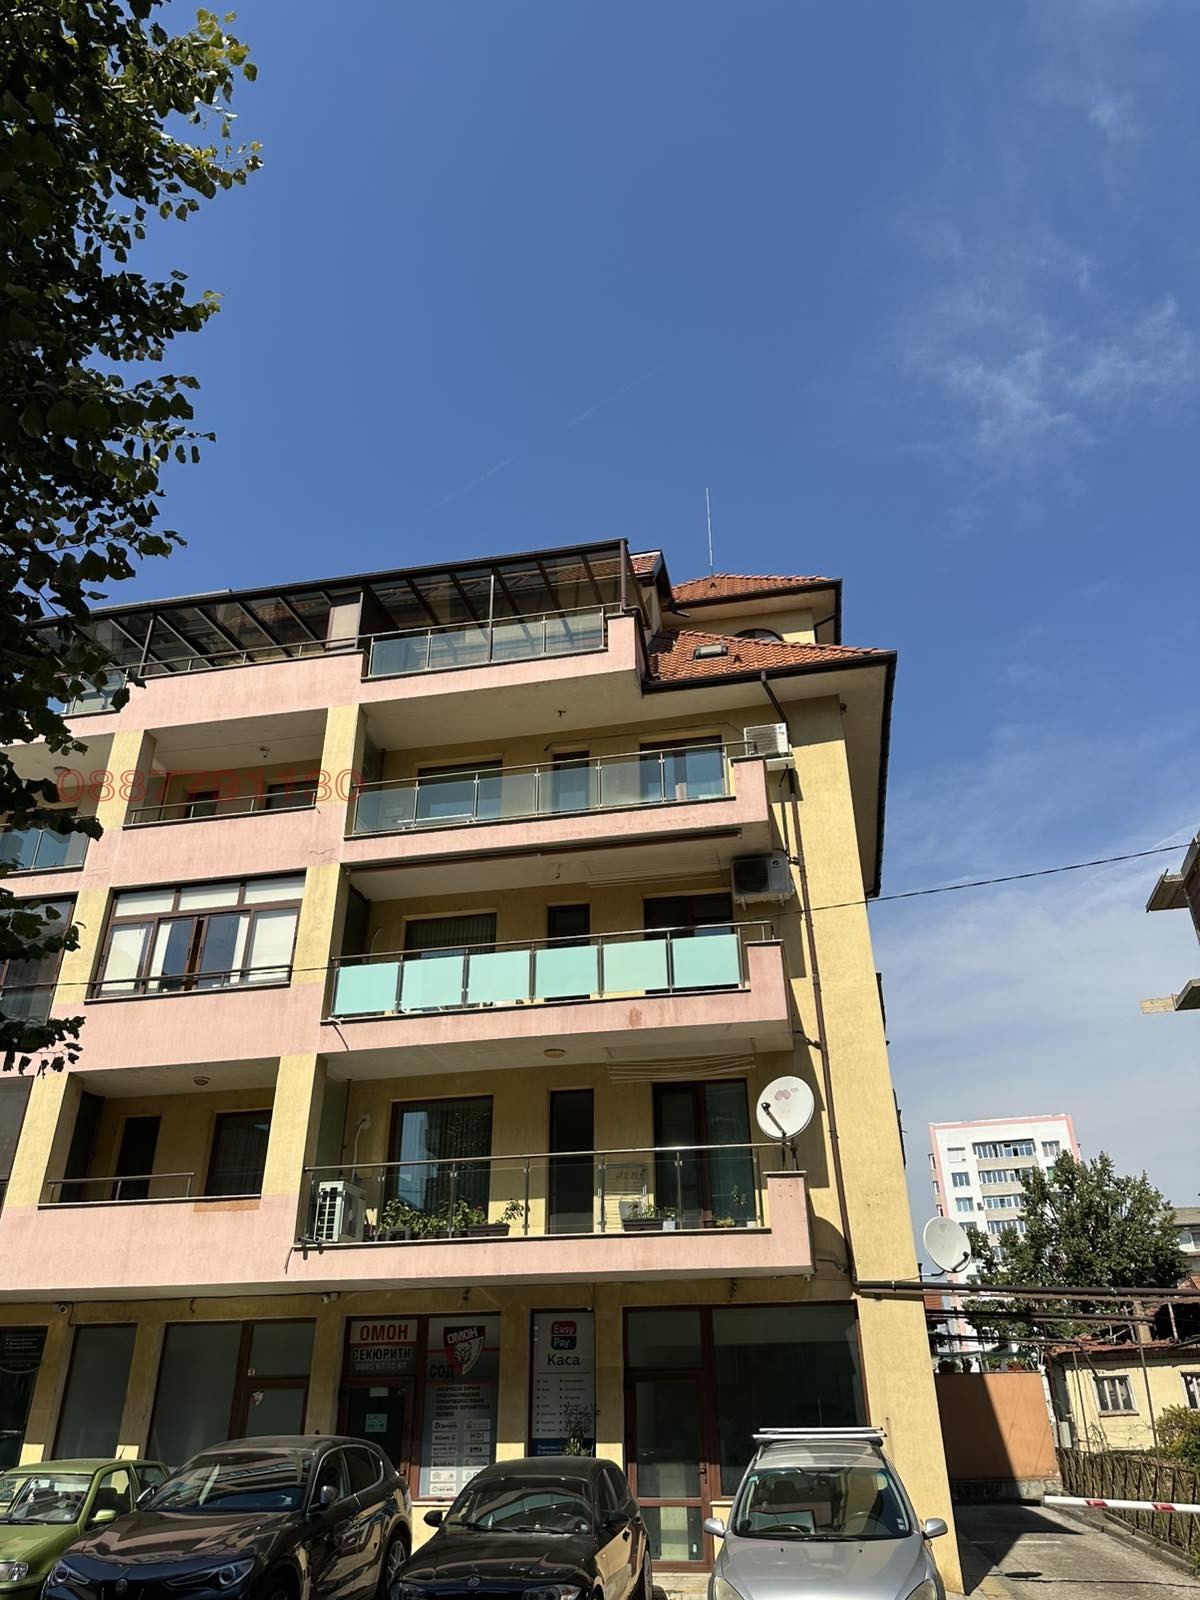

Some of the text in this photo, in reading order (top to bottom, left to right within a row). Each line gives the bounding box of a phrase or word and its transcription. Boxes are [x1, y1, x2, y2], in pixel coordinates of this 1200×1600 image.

[360, 1325, 408, 1341] ОМОН
[447, 1327, 478, 1344] ОМОН
[553, 1324, 576, 1335] Easy
[553, 1337, 570, 1349] Pay
[352, 1348, 411, 1361] СЕКЮРИТИ
[547, 1353, 581, 1367] Каса
